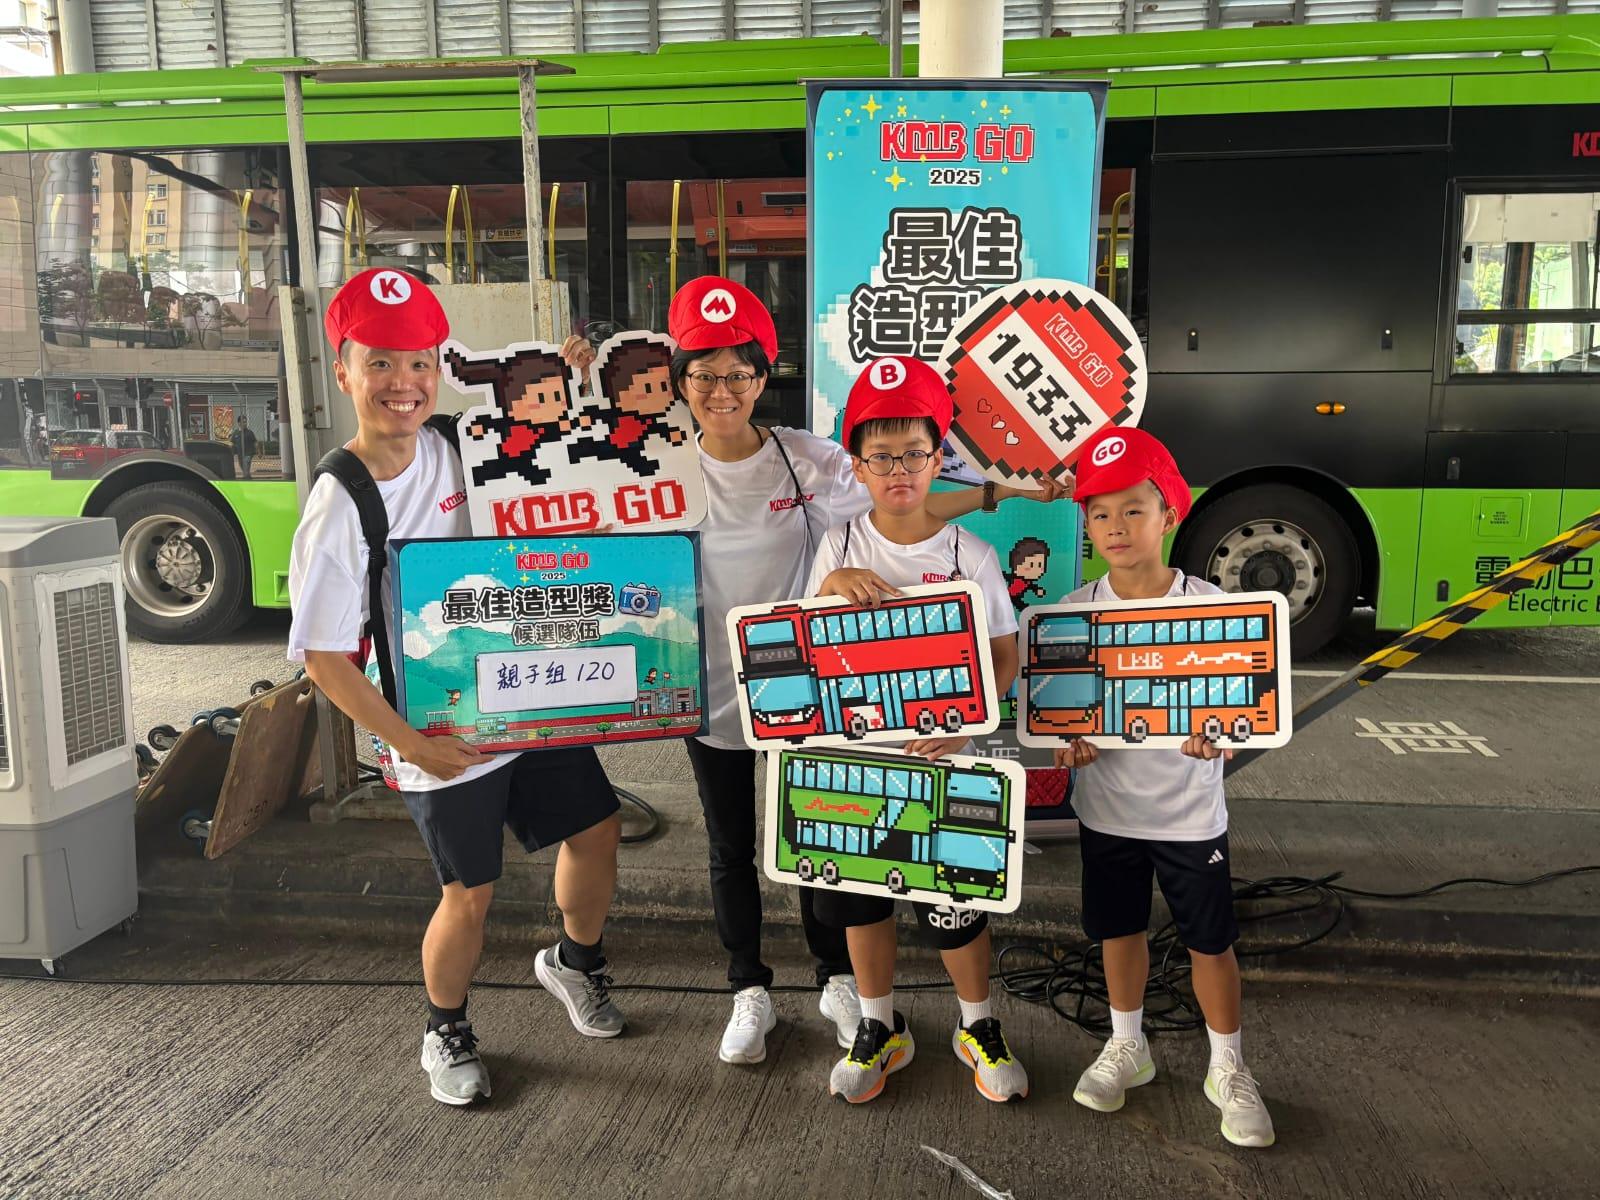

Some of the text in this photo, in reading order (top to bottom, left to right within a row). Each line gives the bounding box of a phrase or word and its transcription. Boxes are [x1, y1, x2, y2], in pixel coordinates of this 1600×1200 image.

[880, 121, 1035, 163] KMB GO
[929, 168, 982, 186] 2025
[885, 208, 1020, 282] 最佳
[379, 278, 403, 298] K
[704, 295, 731, 315] M
[1044, 312, 1114, 388] KMB GO
[879, 364, 899, 385] B
[988, 333, 1092, 443] 1933
[1095, 440, 1124, 462] GO
[490, 478, 688, 535] KMB GO
[516, 552, 590, 571] KMB GO
[541, 572, 566, 581] 2025
[443, 583, 614, 622] 最佳造型獎
[1508, 593, 1589, 613] Electric
[512, 621, 600, 645] 候選隊伍
[577, 661, 615, 682] 120
